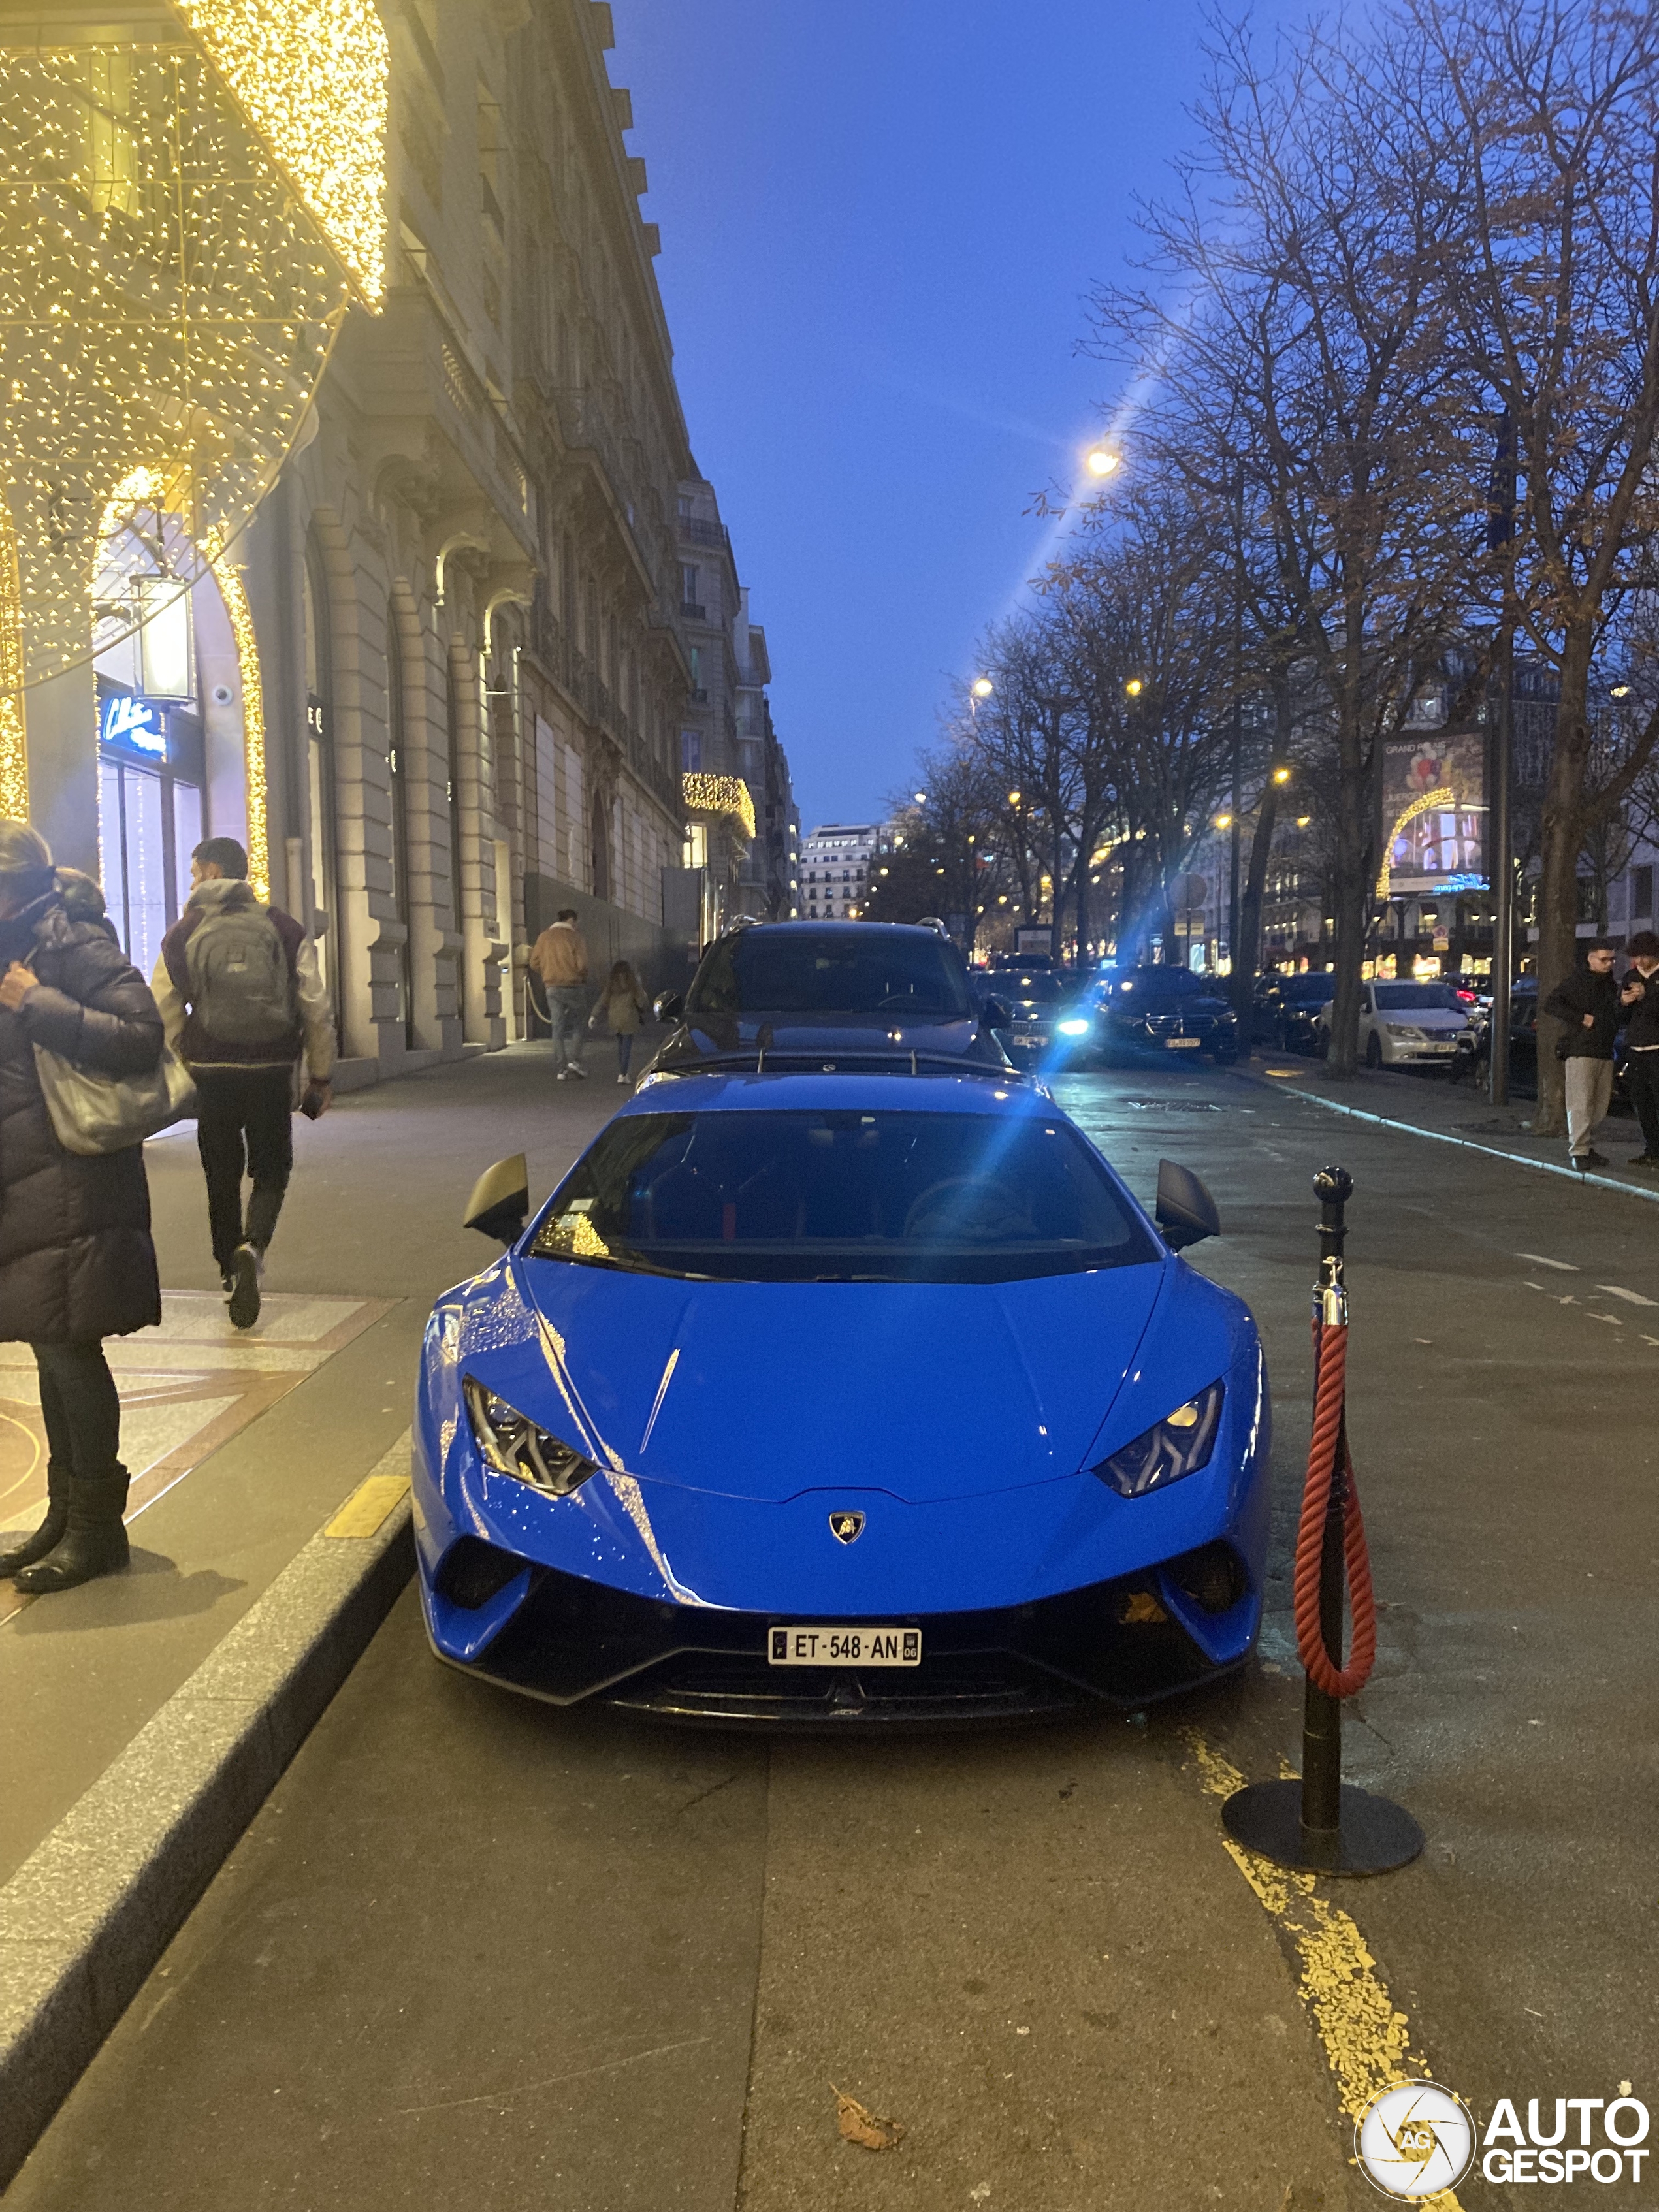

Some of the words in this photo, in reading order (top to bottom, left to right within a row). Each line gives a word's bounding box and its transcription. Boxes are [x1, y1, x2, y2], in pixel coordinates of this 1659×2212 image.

[1386, 745, 1416, 754] GRAND
[796, 1635, 897, 1658] ET-548-AN
[904, 1648, 917, 1657] 06
